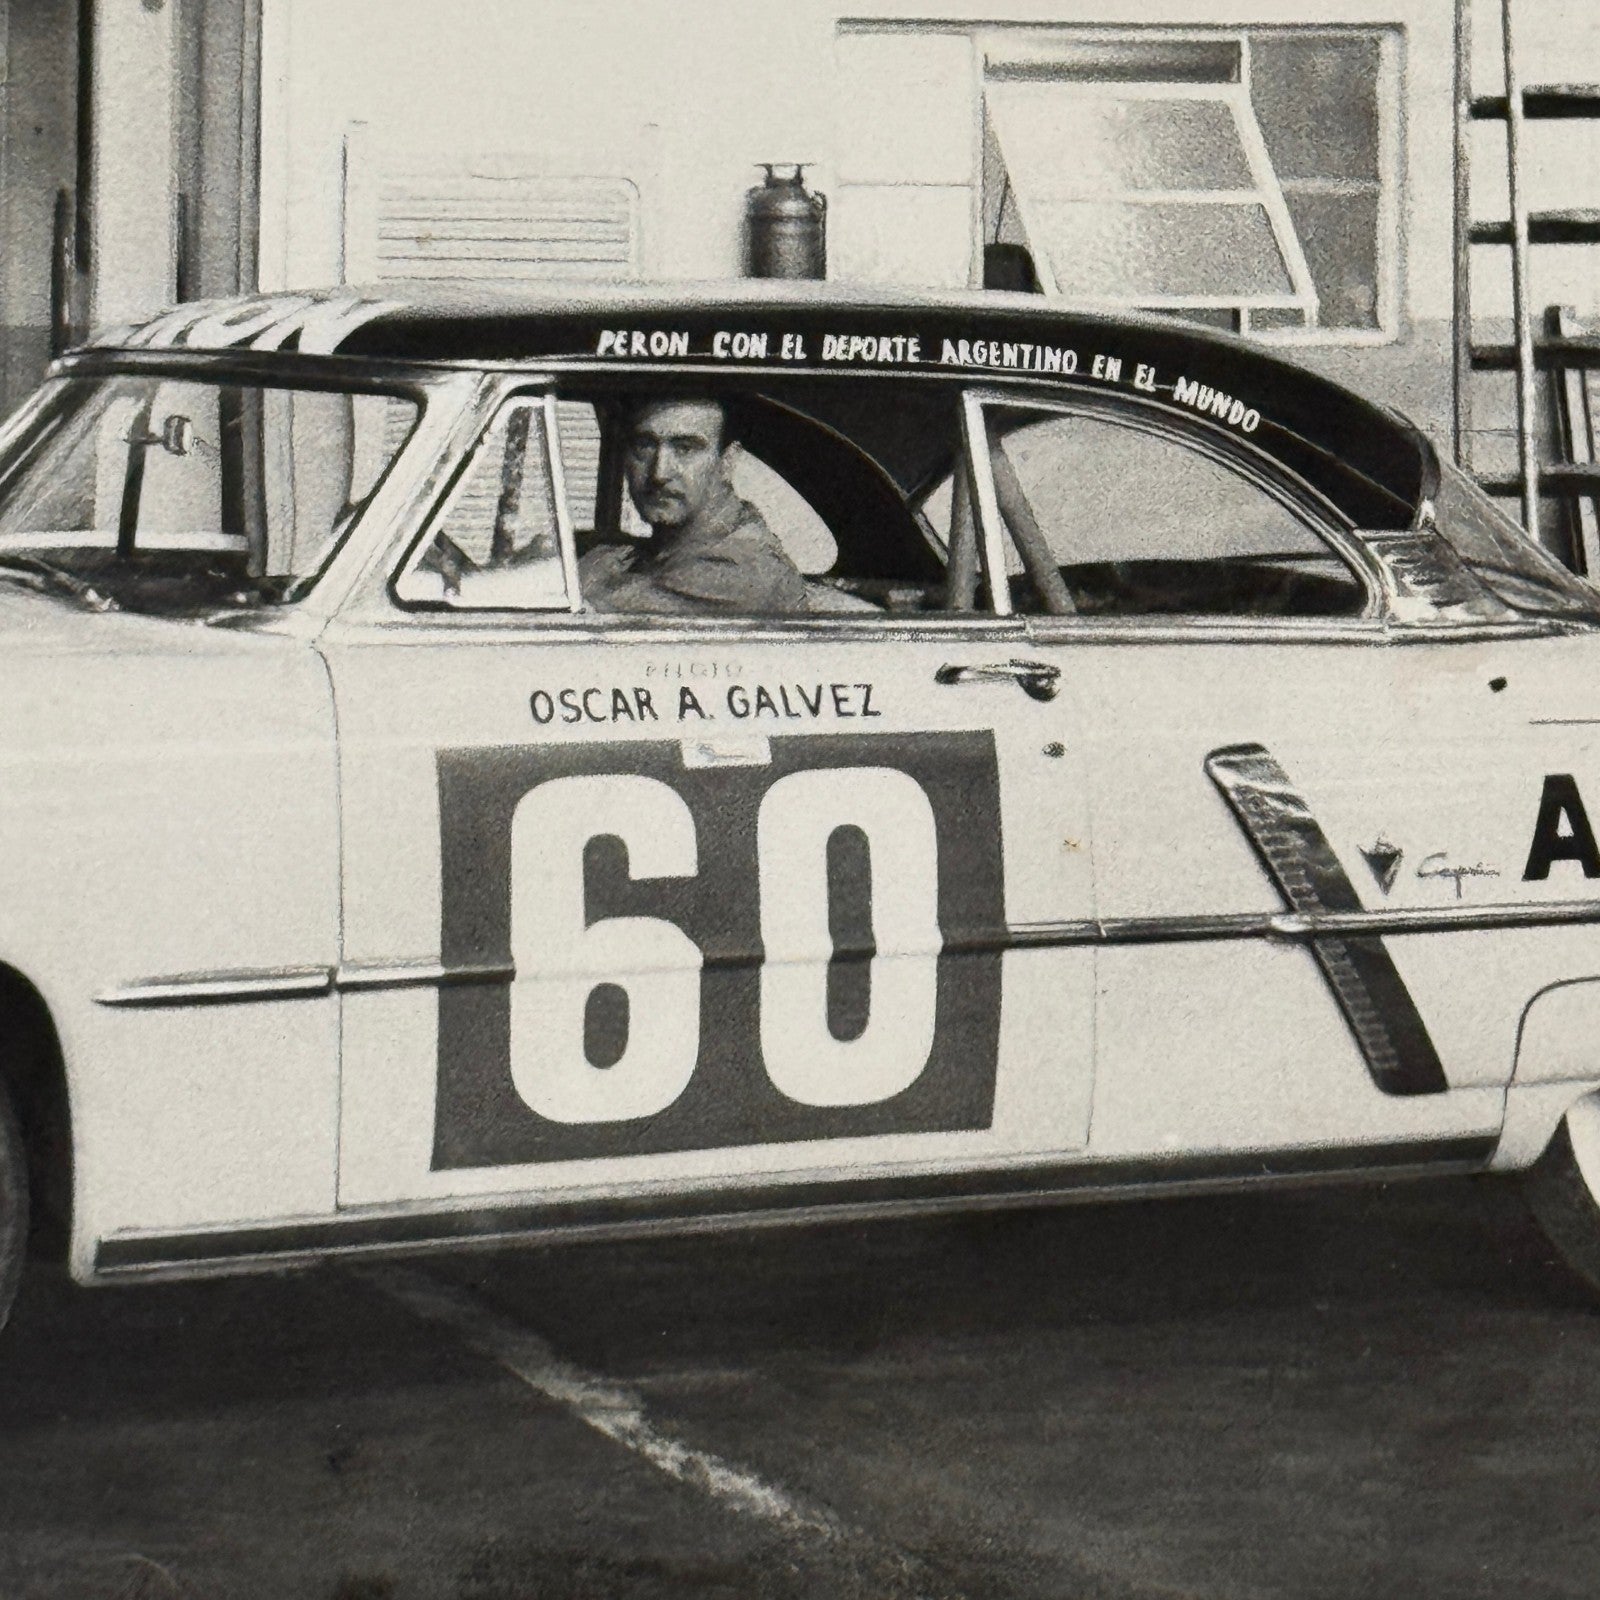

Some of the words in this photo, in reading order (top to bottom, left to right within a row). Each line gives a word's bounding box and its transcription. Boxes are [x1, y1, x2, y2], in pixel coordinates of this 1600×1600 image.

[596, 329, 690, 357] PERON
[712, 331, 768, 359] CON
[780, 333, 807, 360] EL
[821, 334, 921, 363] DEPORTE
[941, 337, 1078, 374] ARGENTINO
[1092, 354, 1123, 382] EN
[1133, 363, 1157, 393] EL
[1173, 376, 1261, 433] MUNDO
[529, 687, 659, 725] OSCAR
[726, 683, 882, 719] GALVEZ
[1520, 772, 1600, 882] A
[509, 766, 944, 1125] 60
